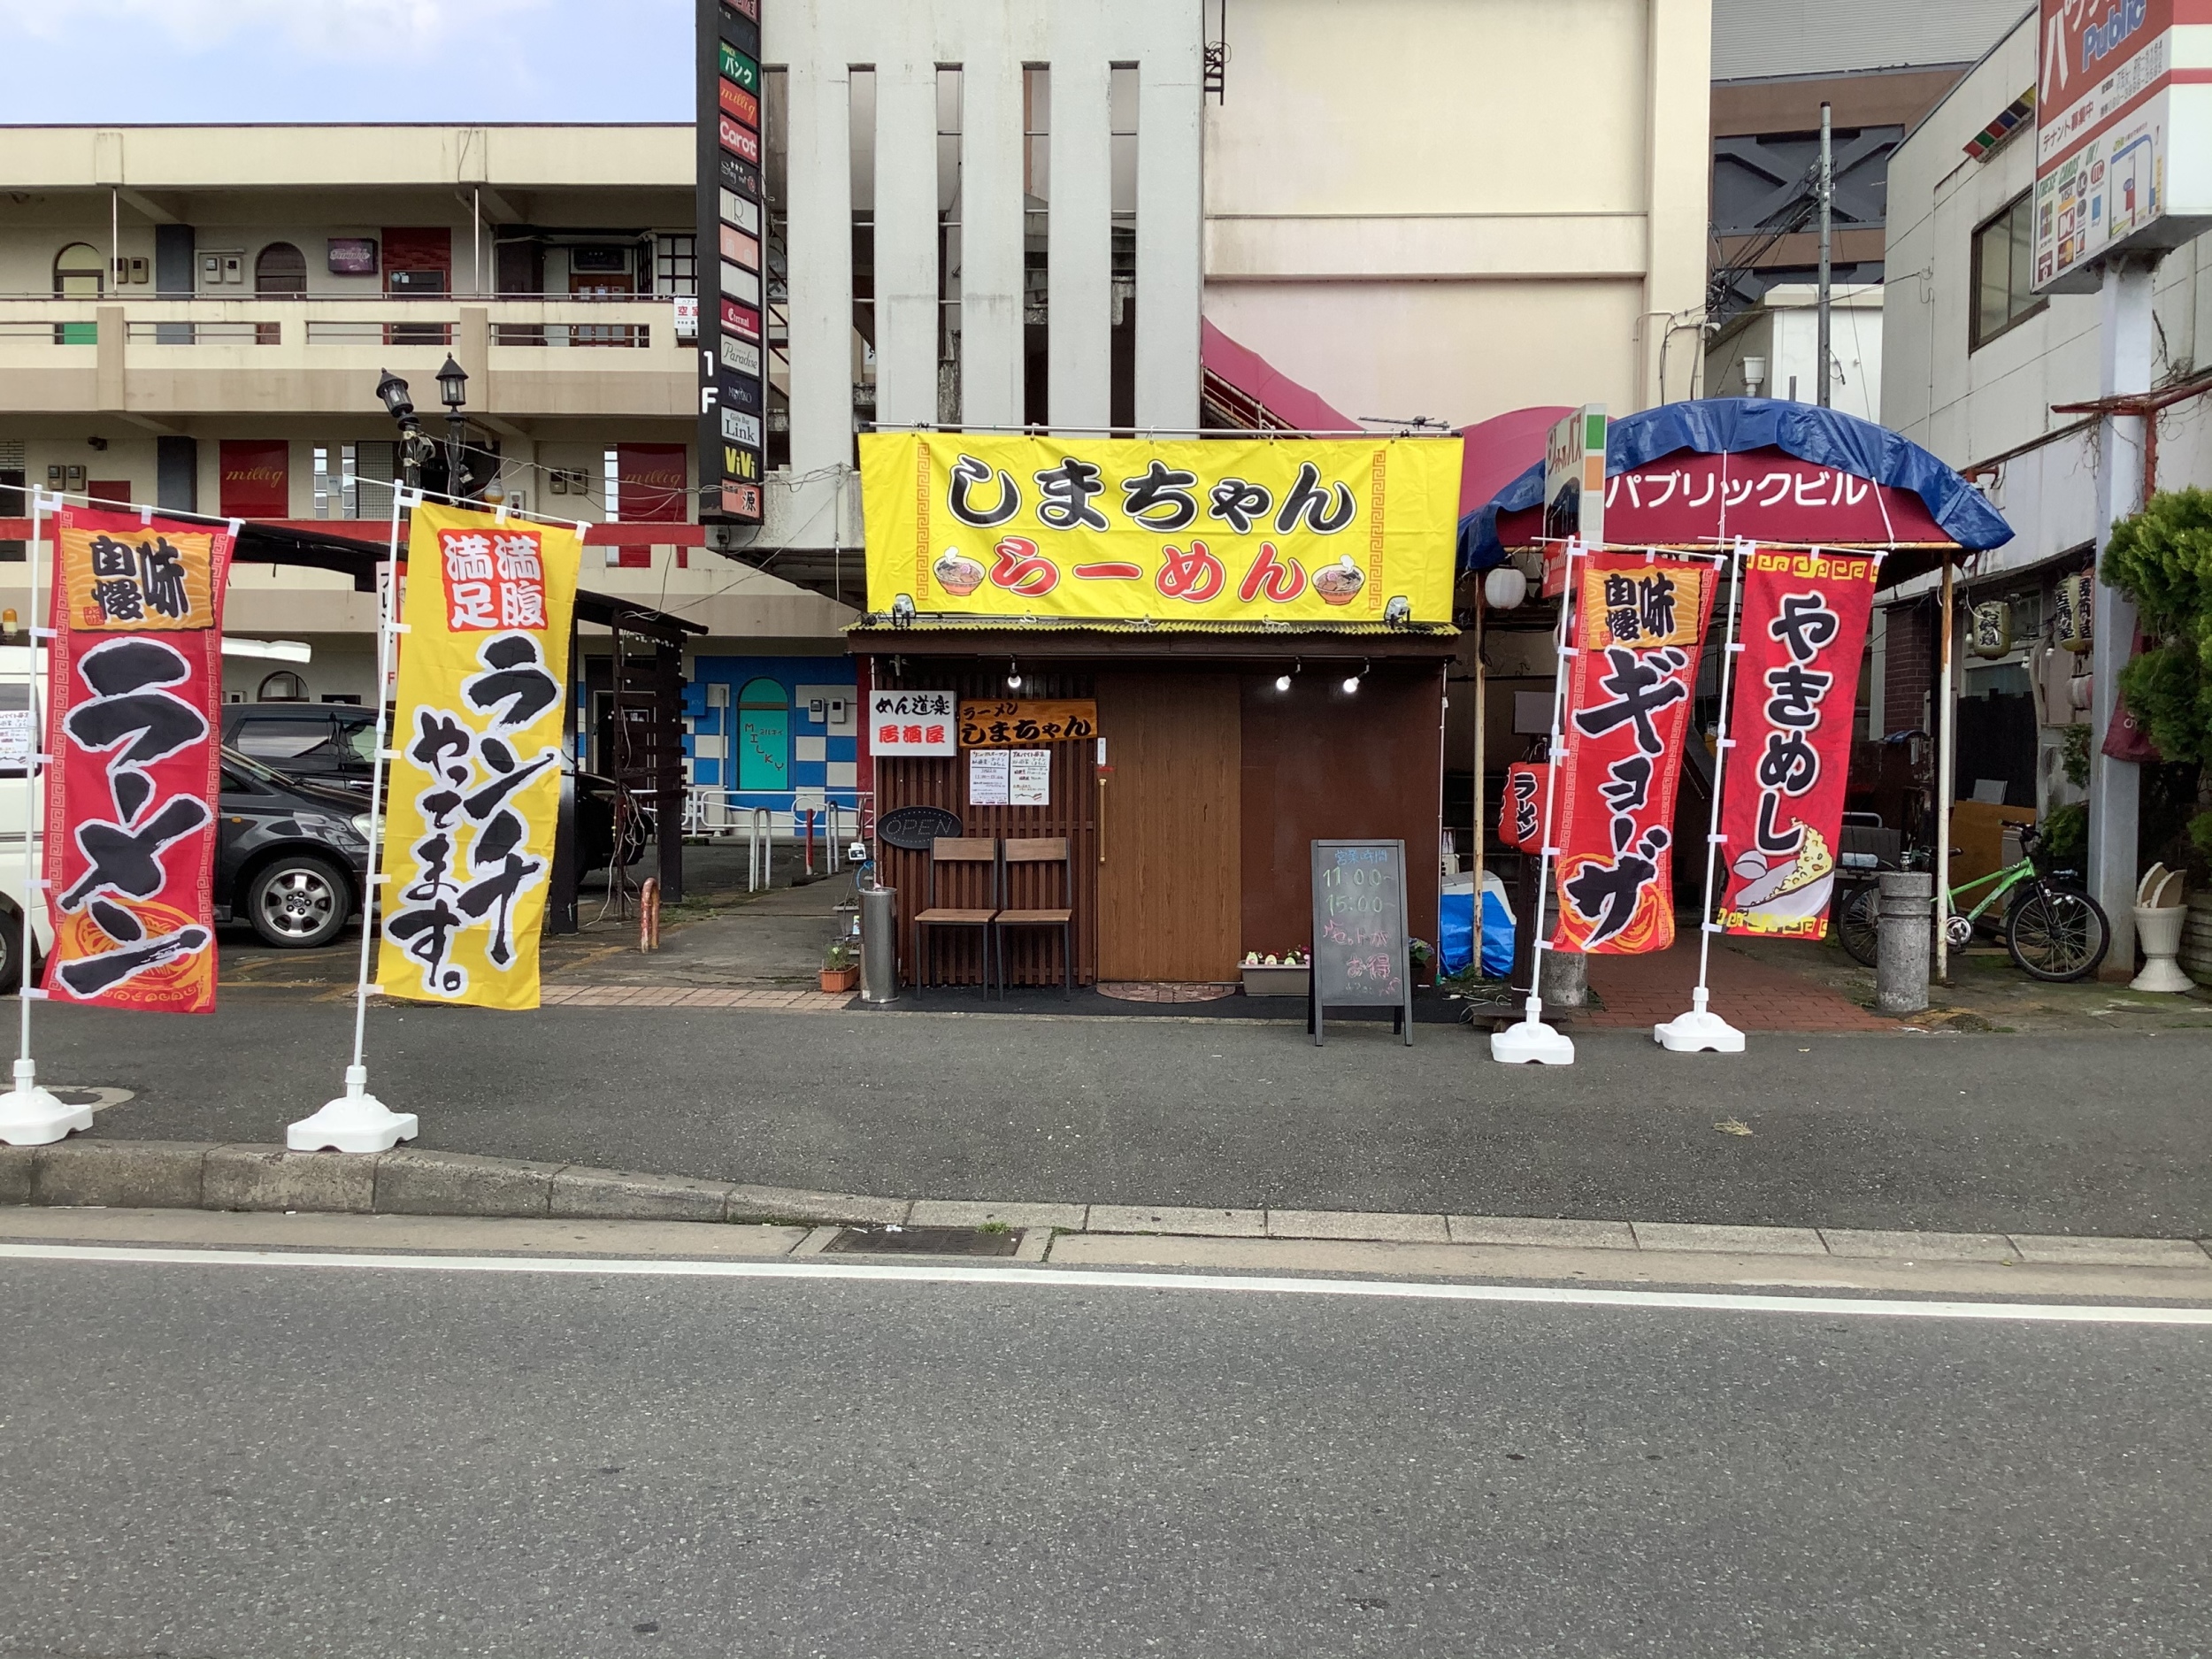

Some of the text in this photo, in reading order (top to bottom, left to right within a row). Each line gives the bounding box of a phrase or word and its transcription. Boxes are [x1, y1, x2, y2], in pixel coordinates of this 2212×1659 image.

[2083, 0, 2147, 73] Public
[721, 87, 756, 121] millig
[719, 121, 757, 157] Carot
[733, 197, 744, 224] R
[723, 342, 758, 369] Paradise
[725, 419, 756, 442] Link
[226, 466, 283, 488] millig
[725, 445, 756, 480] ViVi
[742, 490, 757, 512] 源
[948, 453, 1359, 534] しまちゃん
[1605, 469, 1869, 509] パブリックビル
[135, 535, 189, 618] 味
[444, 534, 498, 629] 満足
[493, 533, 547, 629] 満腹
[989, 534, 1308, 604] らーめん
[1638, 572, 1675, 638] 味
[875, 695, 951, 716] めん道楽
[963, 703, 1018, 721] ラーメン
[1755, 589, 1839, 856] やきめし
[878, 725, 947, 744] 居酒屋
[961, 715, 1092, 745] しまちゃん
[453, 632, 559, 968] ランチ
[1563, 644, 1687, 949] ギョーザ
[56, 636, 213, 999] ラーメン
[886, 818, 953, 836] OPEN
